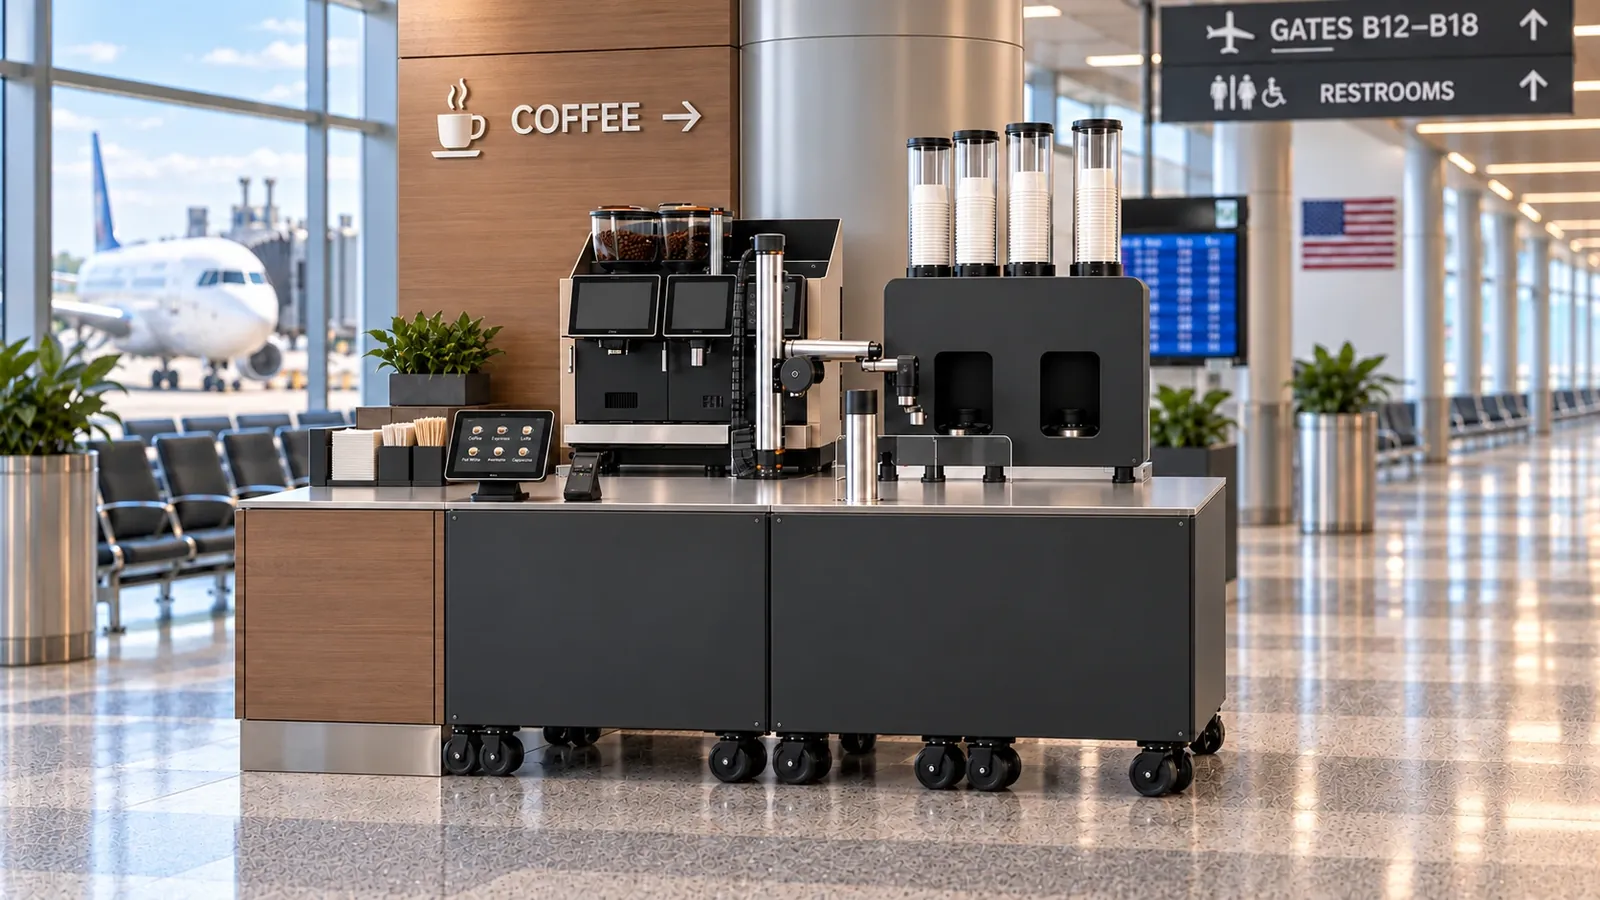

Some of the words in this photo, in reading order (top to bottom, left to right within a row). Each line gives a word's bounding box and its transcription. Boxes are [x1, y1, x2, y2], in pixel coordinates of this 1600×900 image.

[1270, 16, 1354, 42] GATES
[1320, 80, 1455, 105] RESTROOMS
[511, 102, 641, 135] COFFEE
